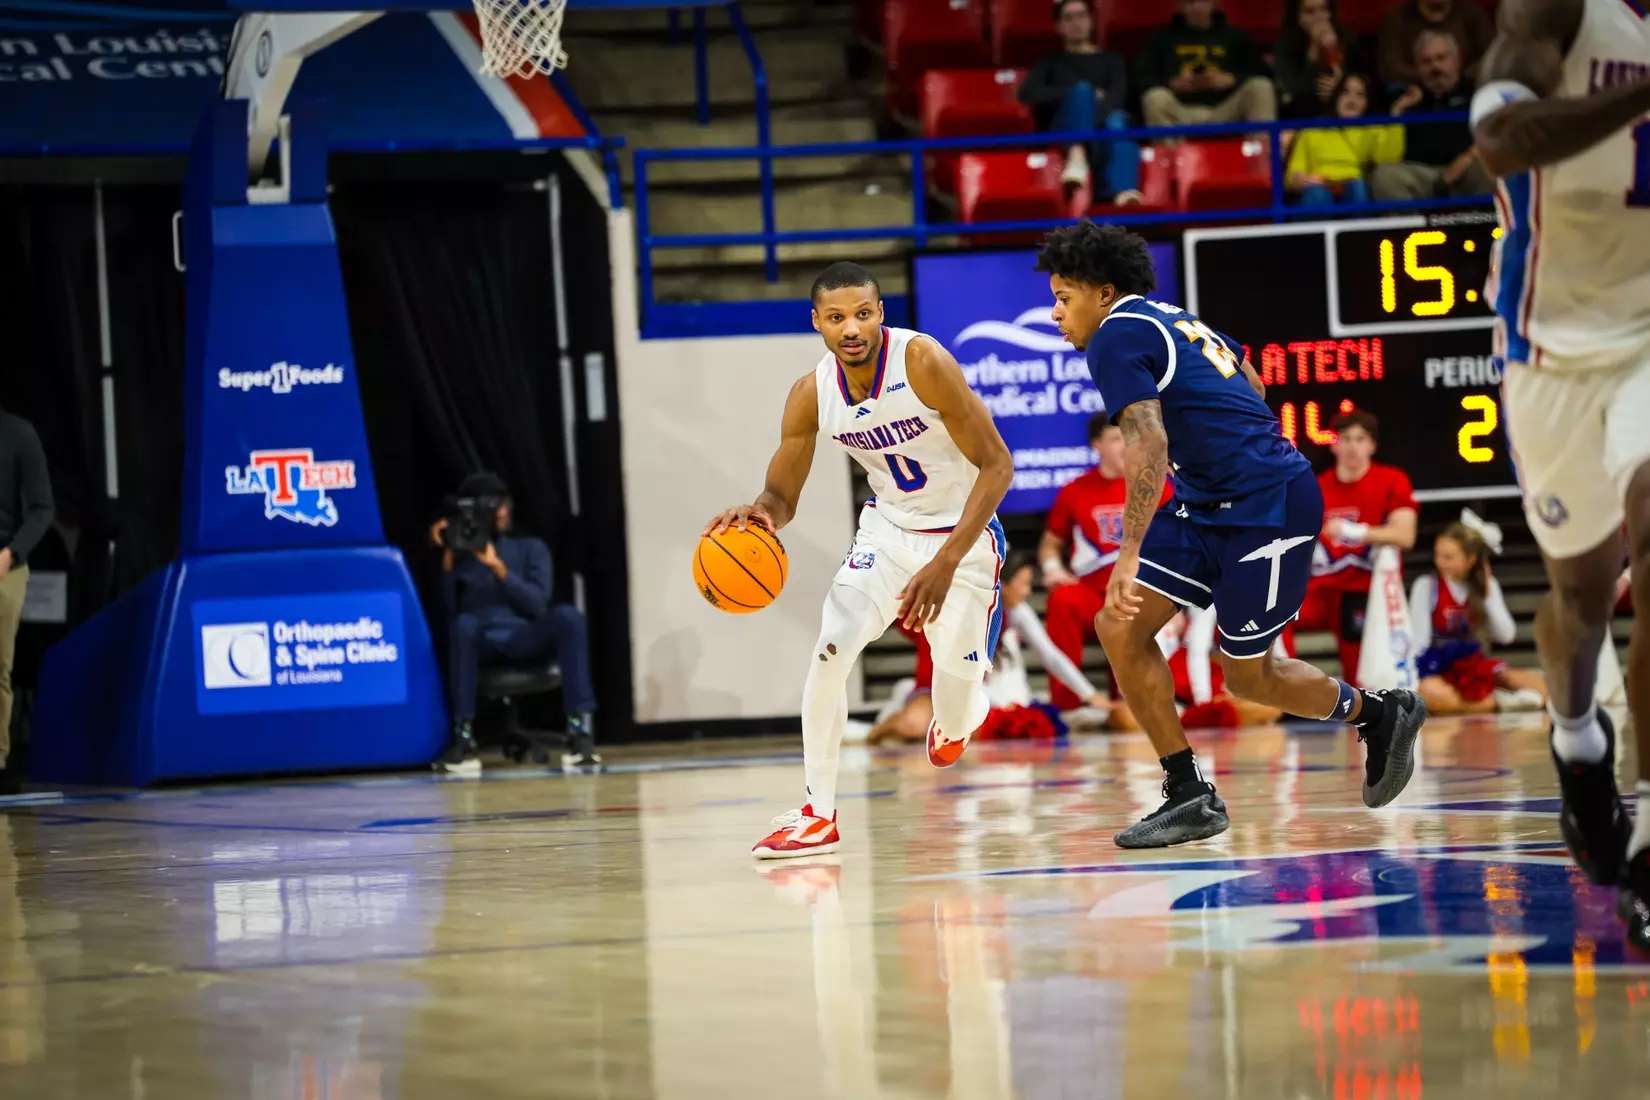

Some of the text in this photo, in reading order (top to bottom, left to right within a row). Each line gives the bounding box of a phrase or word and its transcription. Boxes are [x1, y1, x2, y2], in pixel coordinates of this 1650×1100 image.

[53, 28, 230, 55] Louisi
[1424, 356, 1502, 388] PERIO
[975, 382, 1058, 417] edical
[890, 416, 929, 443] TECH
[1457, 394, 1497, 463] 2
[883, 453, 928, 493] 0
[273, 616, 383, 646] Orthopaedic
[275, 638, 398, 671] & Spine Clinic
[276, 668, 343, 685] of Louisiana
